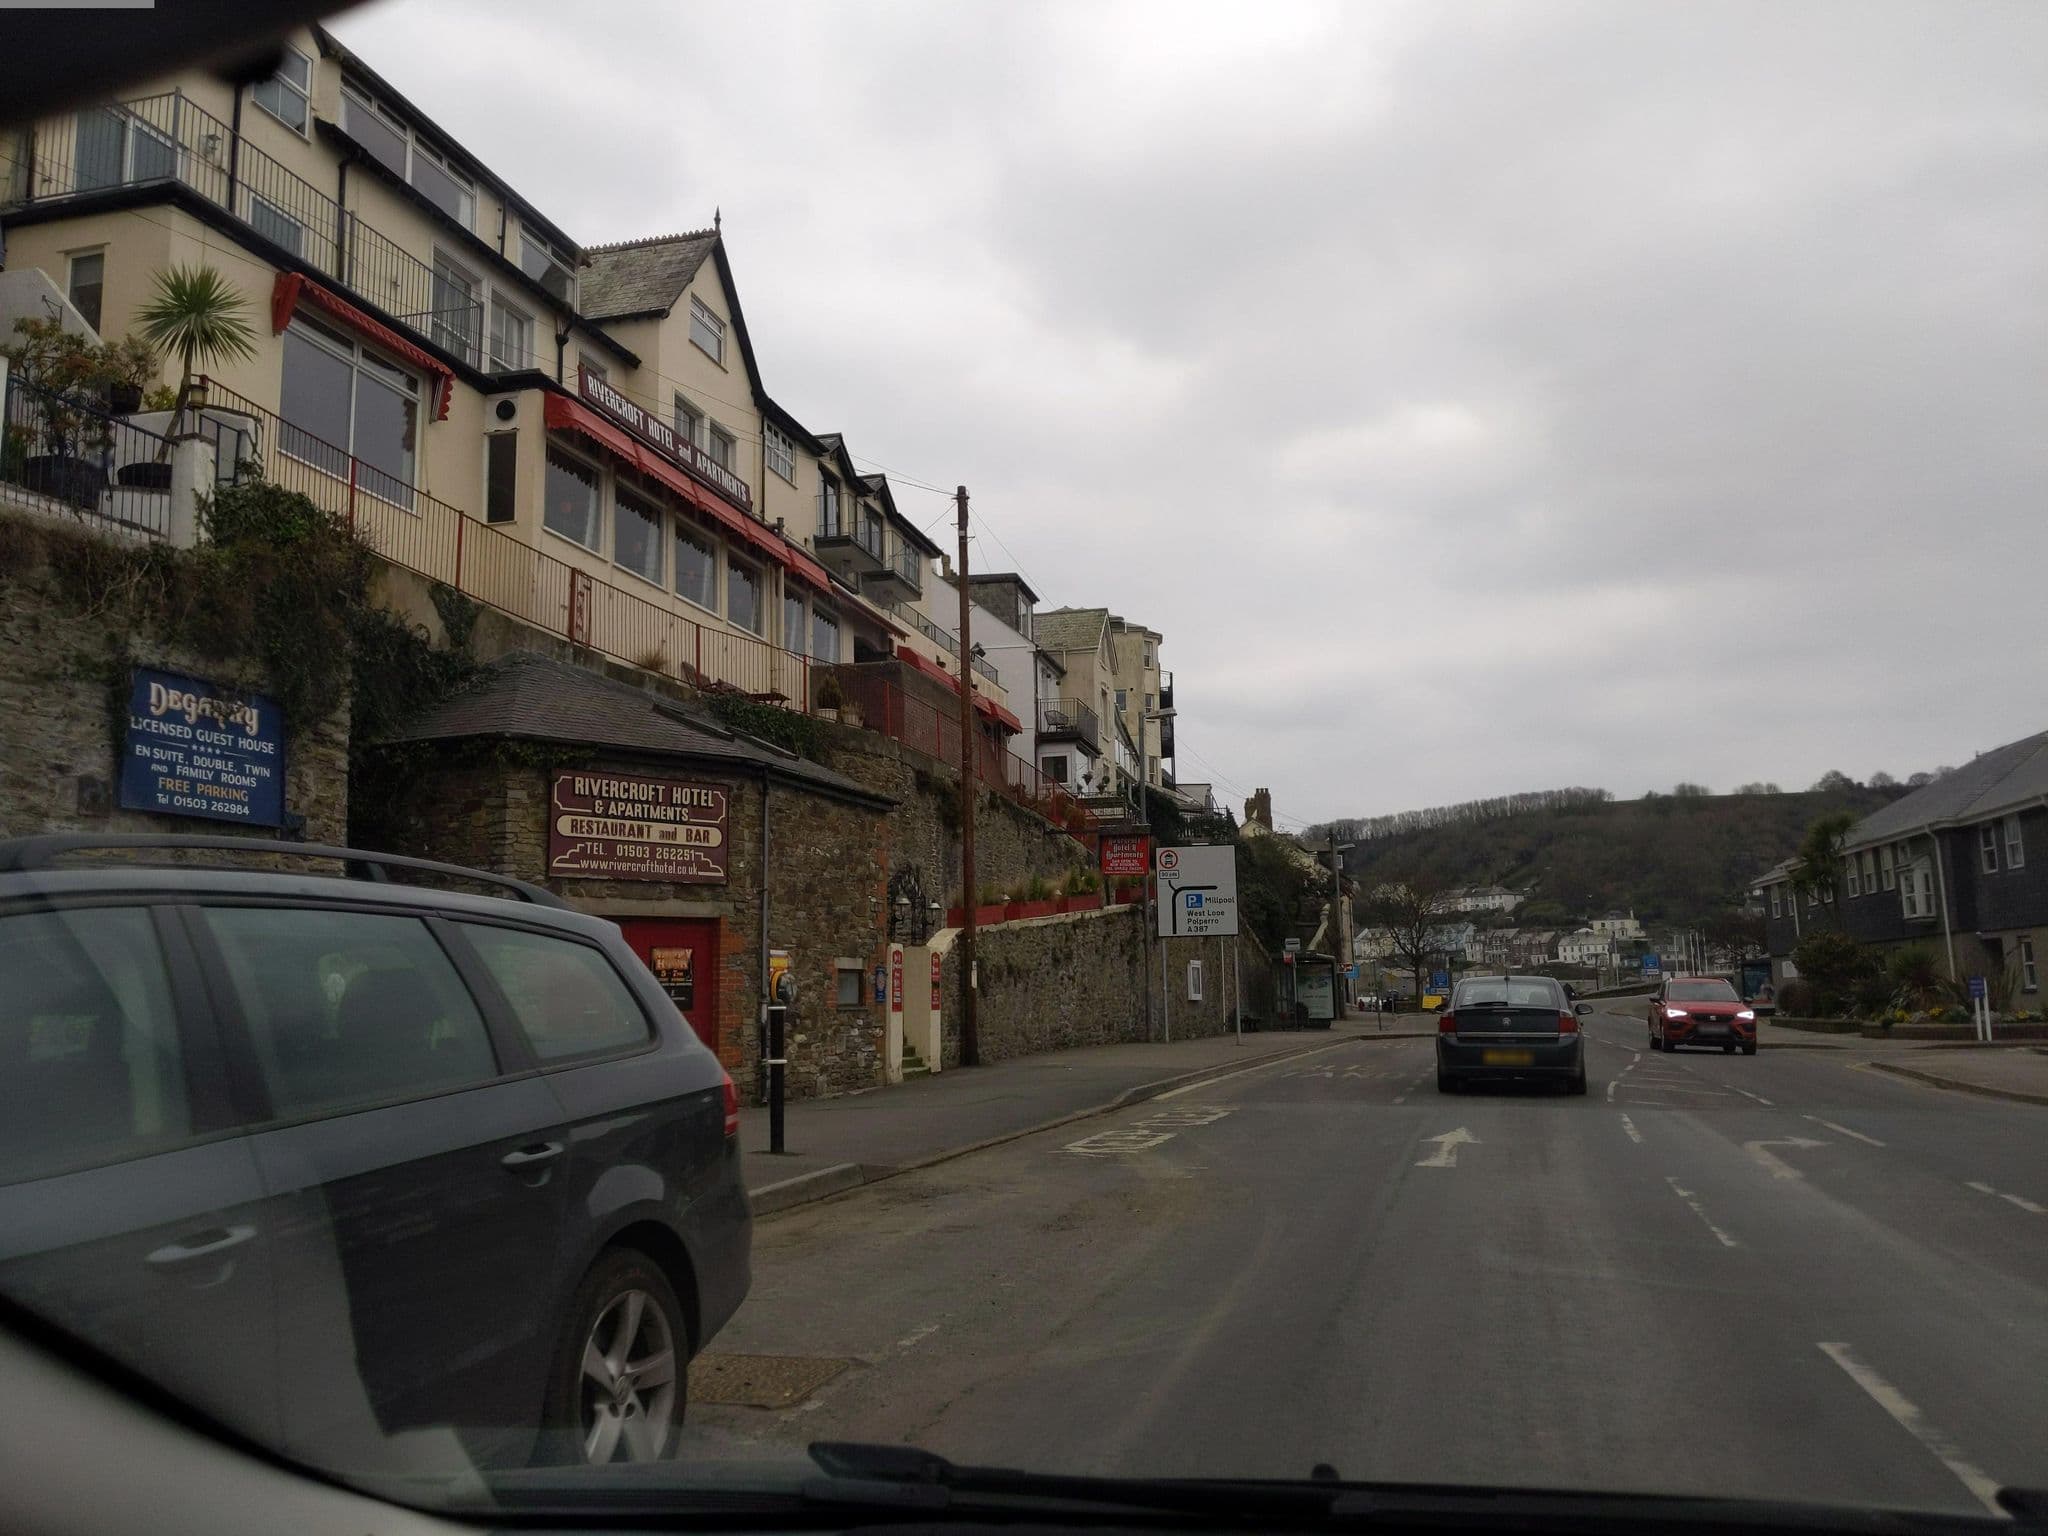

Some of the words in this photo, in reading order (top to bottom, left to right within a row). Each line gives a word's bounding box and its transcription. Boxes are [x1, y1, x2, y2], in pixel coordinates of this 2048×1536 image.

[588, 375, 644, 430] RIVERCROFT
[648, 417, 673, 450] HOTEL
[679, 444, 691, 463] and
[697, 453, 746, 501] APARTMENTS
[131, 716, 192, 738] LICENSED
[196, 730, 234, 746] GUEST
[239, 737, 274, 754] HOUSE
[136, 745, 150, 757] EN
[245, 764, 270, 777] TWIN
[152, 764, 168, 773] AND
[177, 766, 214, 780] FAMILY
[221, 774, 256, 787] ROOMS
[158, 778, 190, 792] FREE
[197, 784, 248, 801] PARKING
[575, 777, 665, 802] RIVERCROFT
[673, 787, 714, 807] HOTEL
[157, 794, 168, 804] Tel
[174, 797, 206, 809] 01503
[211, 801, 249, 815] 262984
[595, 800, 603, 814] &
[608, 801, 689, 822] APARTMENTS
[571, 819, 652, 838] RESTAURANT
[659, 827, 676, 841] and
[686, 828, 710, 843] BAR
[586, 842, 607, 855] TEL.
[617, 845, 649, 857] 01503
[656, 848, 695, 861] 262251
[580, 859, 698, 875] www.rivercrofthotel.co.uk
[1205, 896, 1235, 904] Millpool
